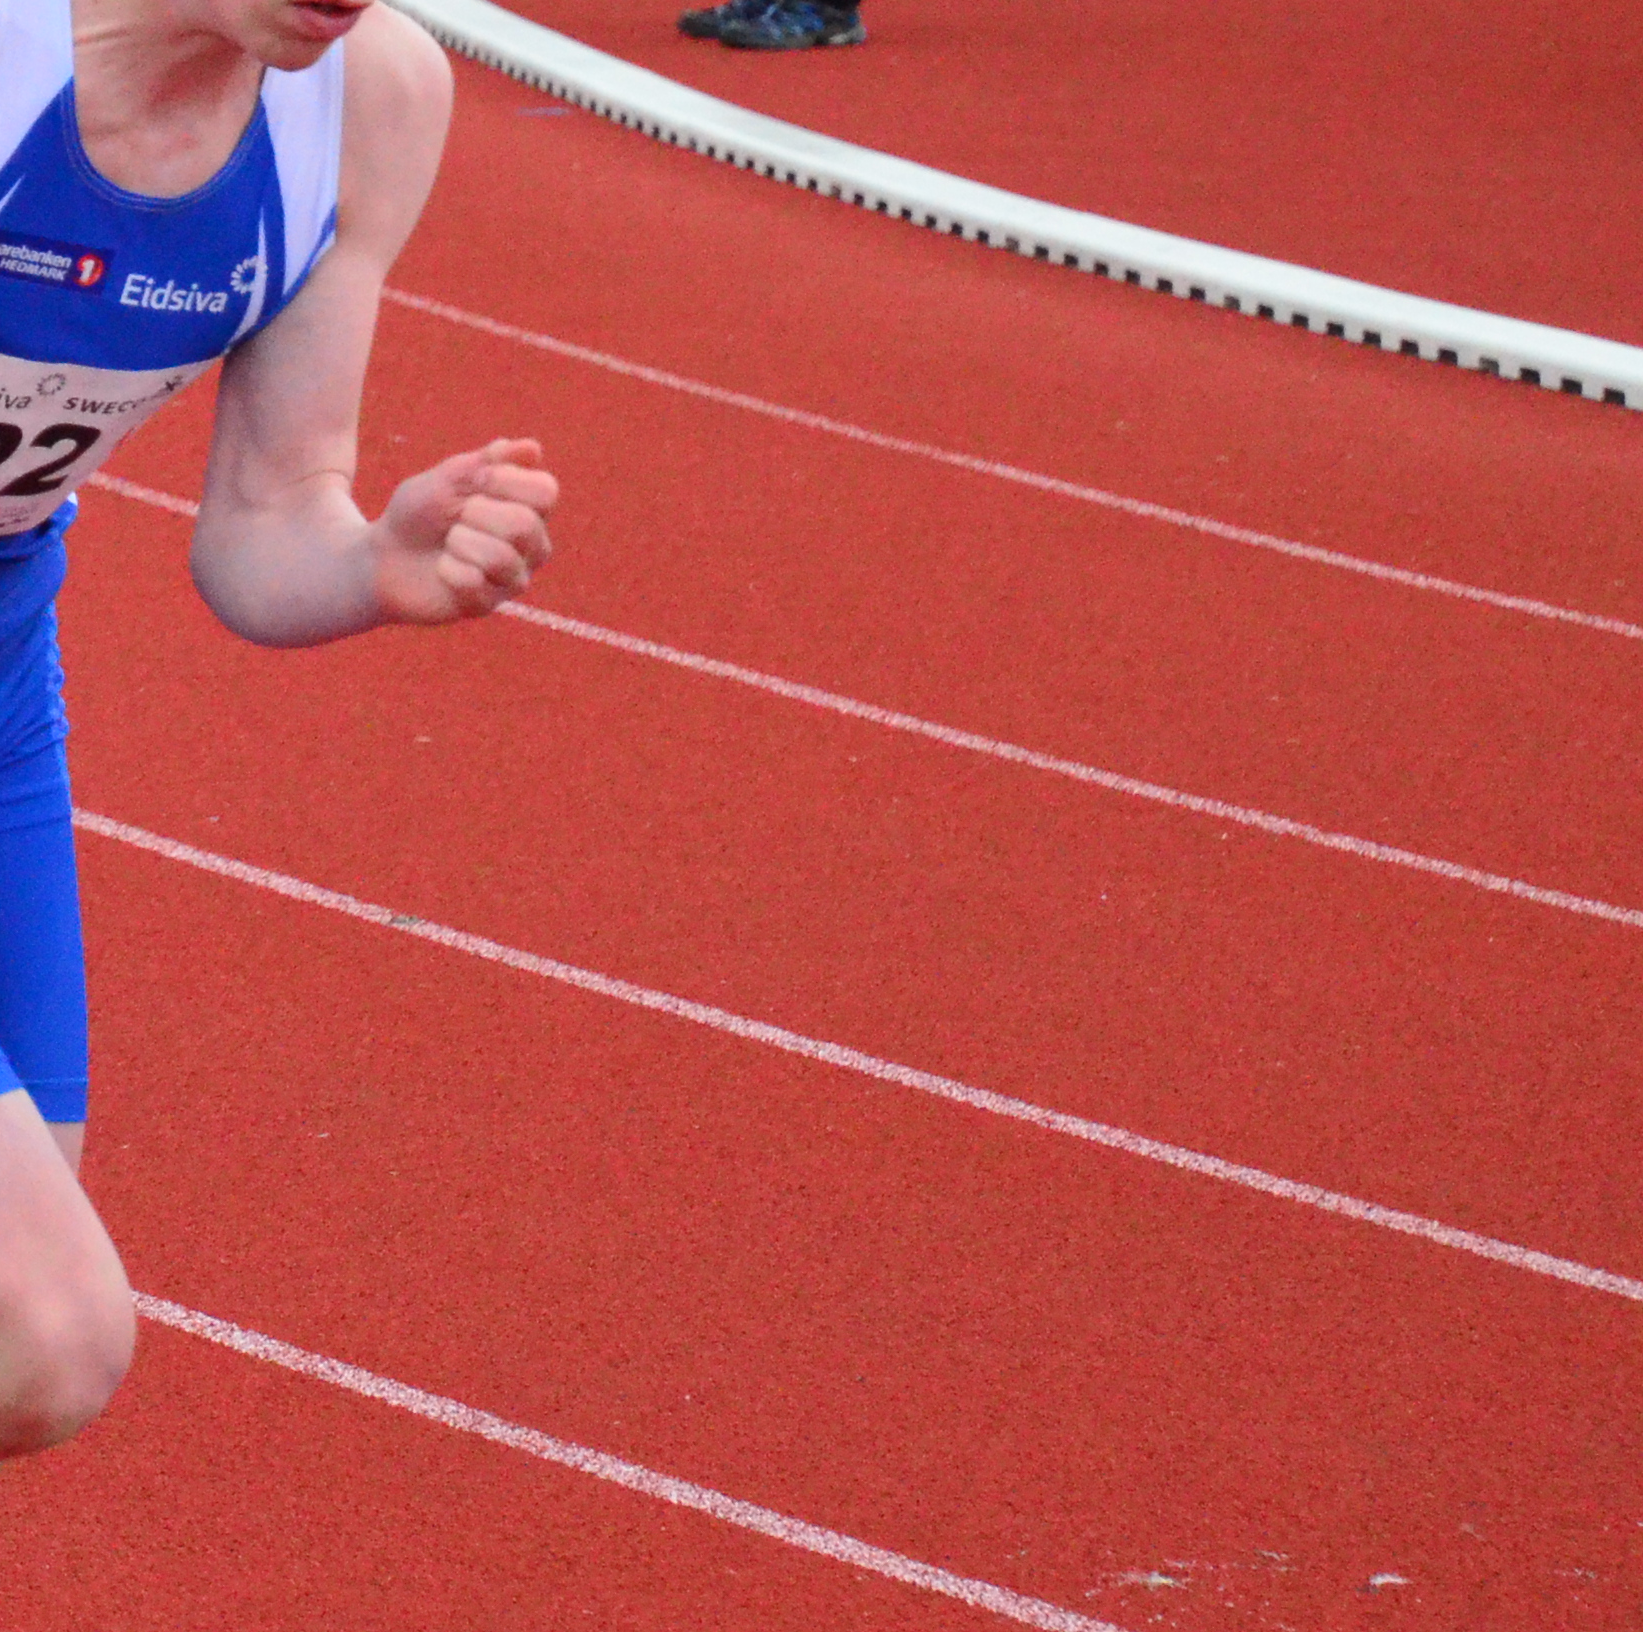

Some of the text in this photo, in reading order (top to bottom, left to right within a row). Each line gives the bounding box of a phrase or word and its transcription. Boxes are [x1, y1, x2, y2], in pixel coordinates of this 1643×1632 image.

[0, 257, 68, 281] HEDMARK
[79, 259, 96, 283] 1
[119, 273, 229, 313] Eidsiva
